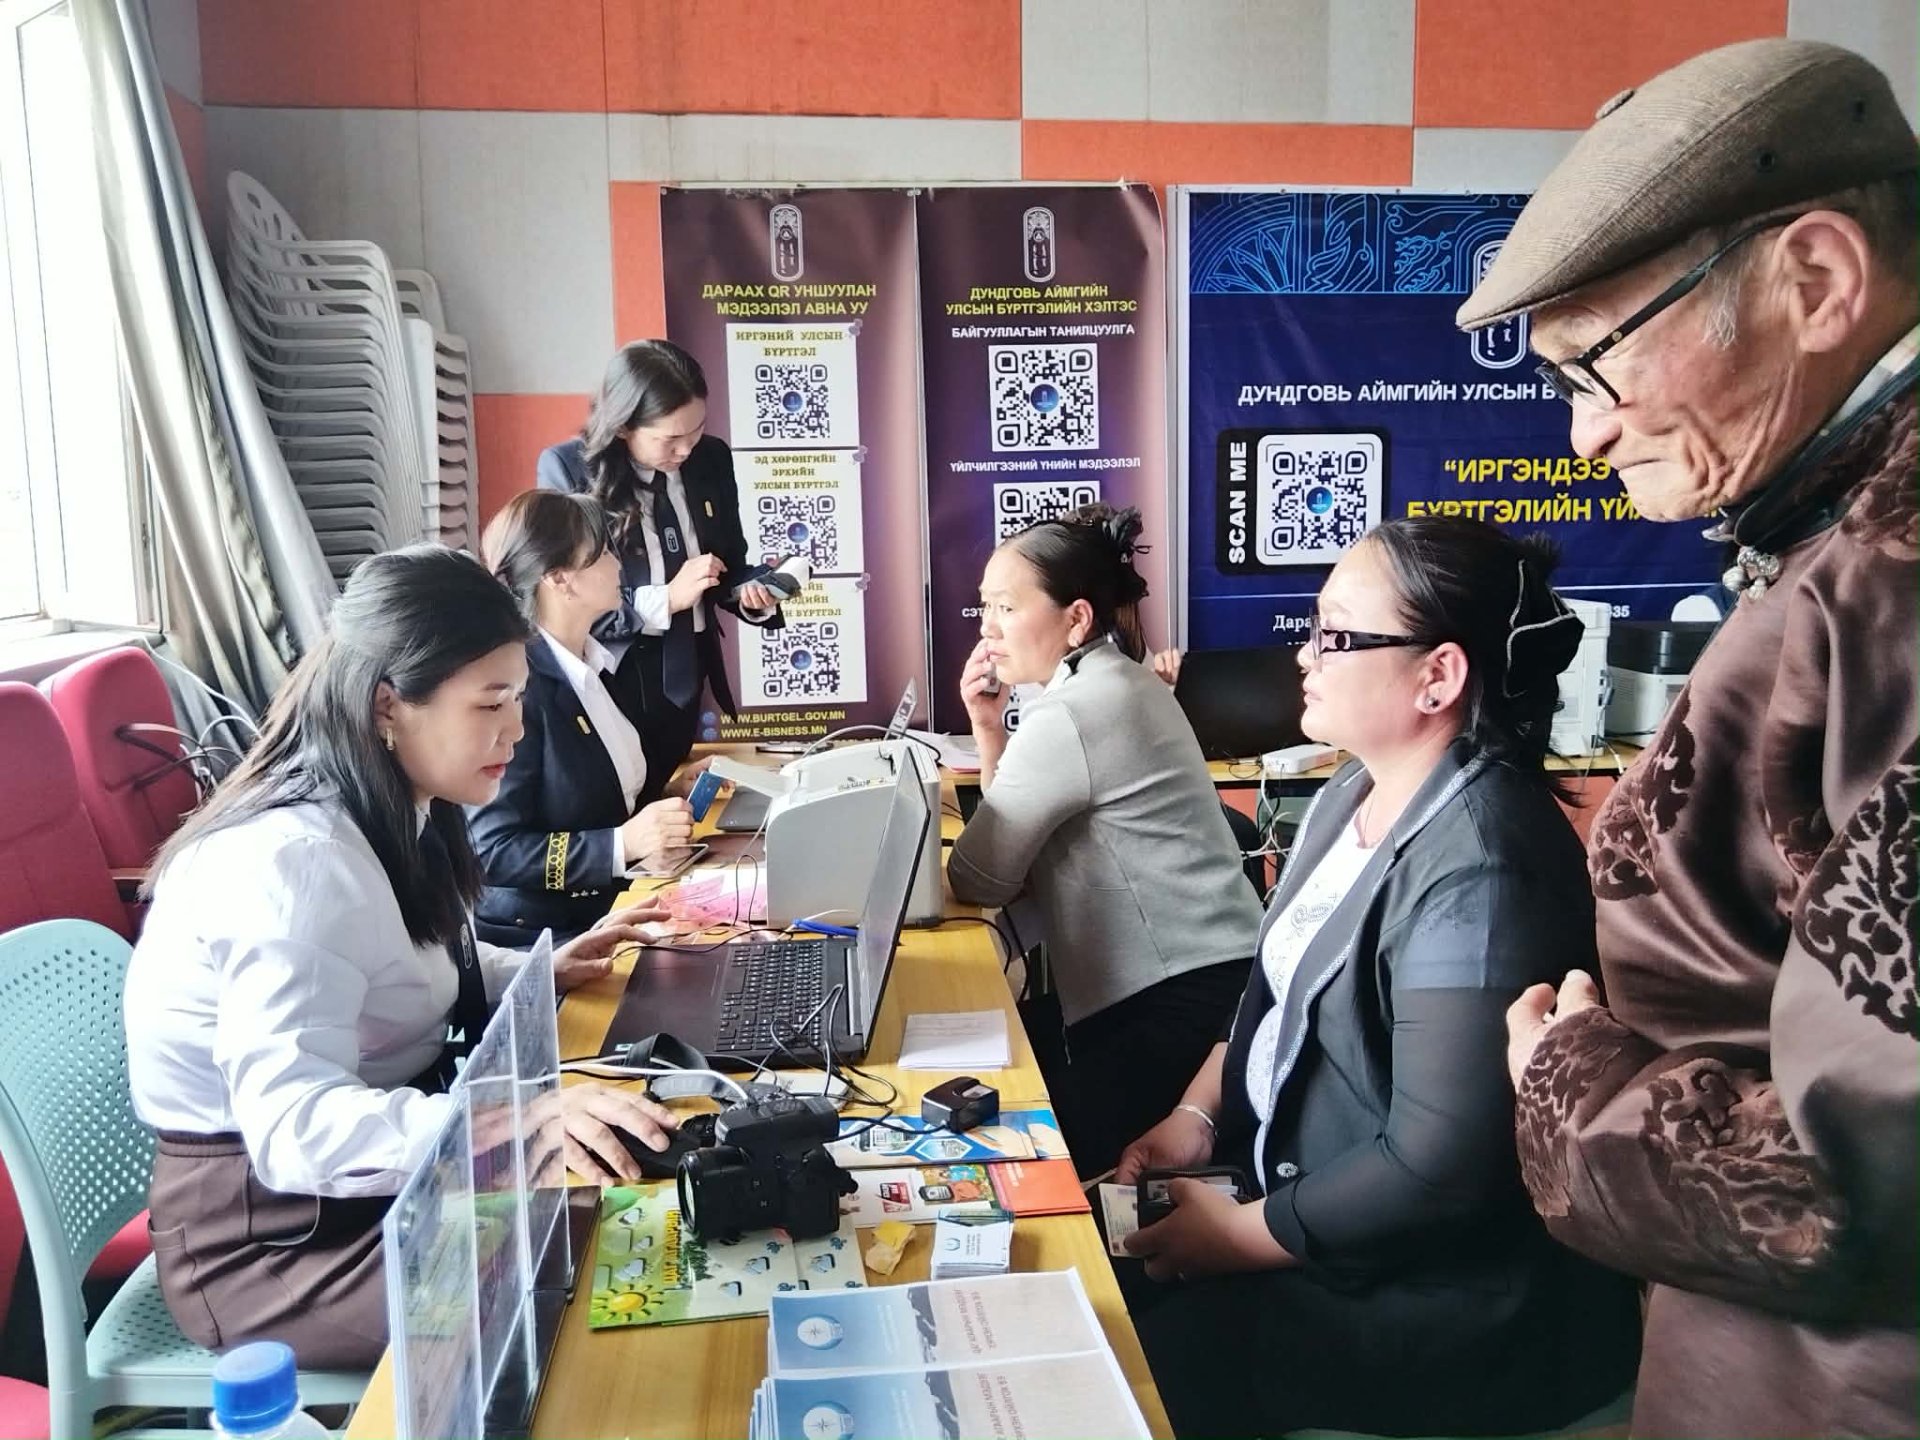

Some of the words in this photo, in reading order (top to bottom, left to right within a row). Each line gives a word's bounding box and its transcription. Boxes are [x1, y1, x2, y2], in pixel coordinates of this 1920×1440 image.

[702, 284, 763, 299] ДАРААХ
[768, 284, 790, 298] QR
[794, 284, 876, 298] УНШУУЛАН
[969, 286, 1041, 301] ДУНДГОВЬ
[1044, 284, 1109, 299] АЙМГИЙН
[717, 302, 801, 317] МЭДЭЭЛЭЛ
[804, 302, 846, 315] АВНА
[849, 301, 869, 315] УУ
[946, 303, 993, 316] УЛСЫН
[997, 300, 1081, 315] БҮРТГЭЛИЙН
[1085, 300, 1137, 313] ХЭЛТЭС
[736, 329, 794, 342] ИРГЭНИЙ
[801, 331, 843, 341] УЛСЫН
[951, 324, 1047, 338] БАЙГУУЛЛАГЫН
[1050, 323, 1135, 338] ТАНИЛЦУУЛГА
[1238, 385, 1351, 406] ДУНДГОВЬ
[1357, 380, 1456, 401] АЙМГИЙН
[1462, 383, 1536, 401] УЛСЫН
[1041, 458, 1077, 471] ҮНИЙН
[1079, 457, 1140, 470] МЭДЭЭЛЭЛ
[1230, 442, 1247, 481] ME
[1229, 491, 1246, 564] SCAN
[720, 710, 846, 724] WW.BURTGEL.GOV.MN
[721, 725, 827, 738] WWW.E-BISNESS.MN
